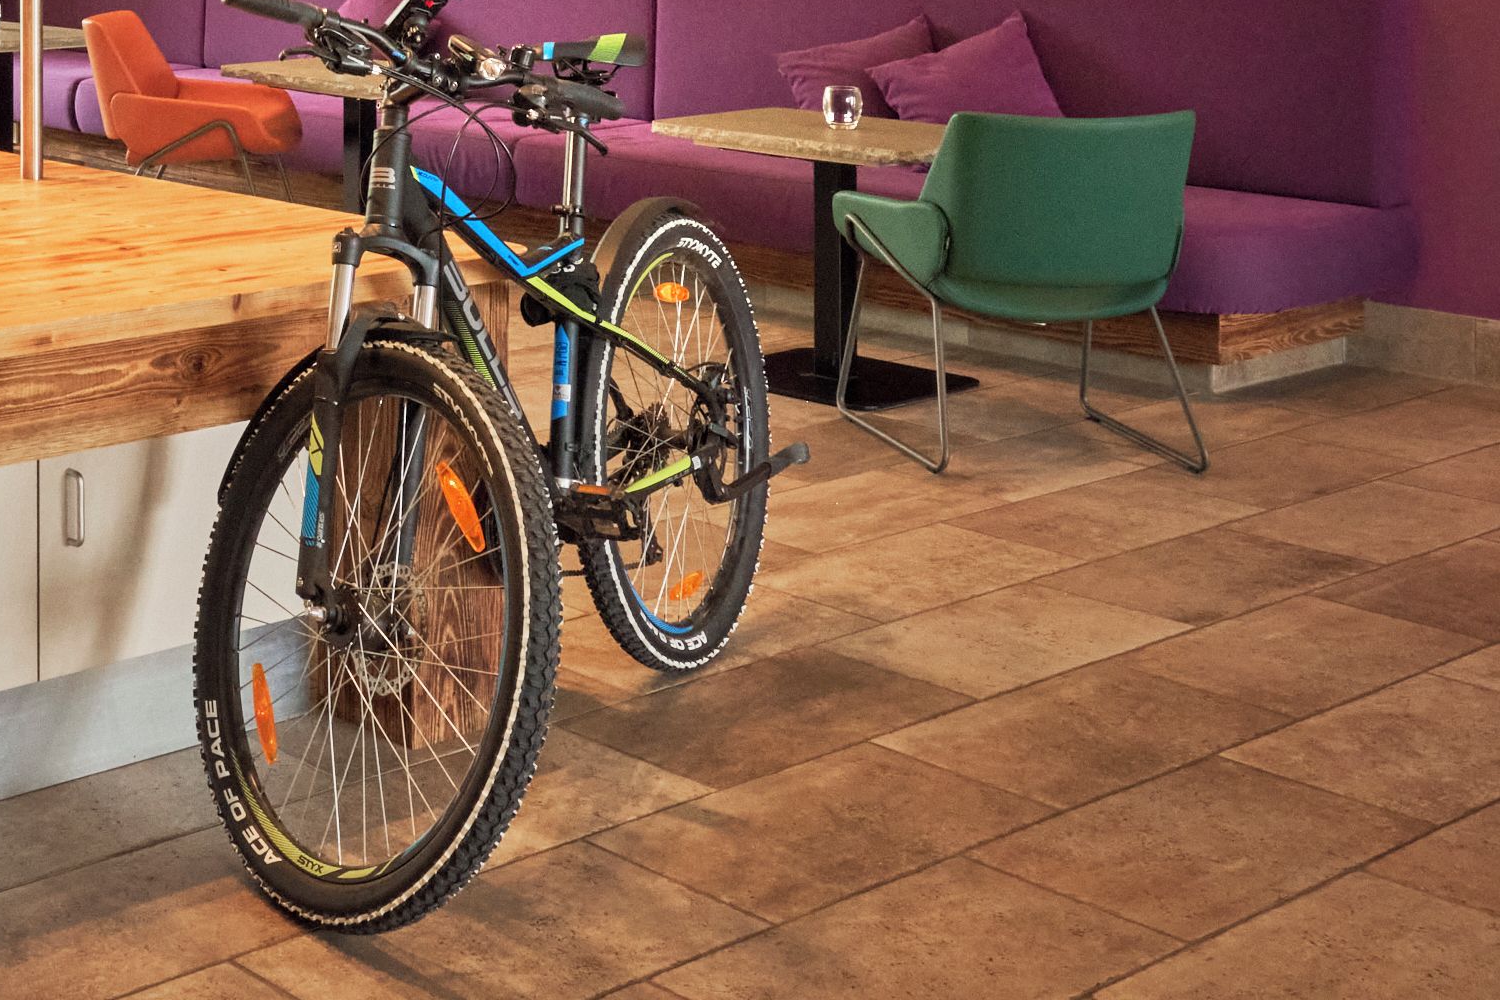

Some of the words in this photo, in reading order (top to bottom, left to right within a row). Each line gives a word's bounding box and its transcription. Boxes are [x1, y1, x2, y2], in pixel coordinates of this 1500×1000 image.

[204, 698, 231, 780] PACE
[223, 787, 247, 822] OF
[242, 824, 283, 866] ACE
[296, 854, 324, 875] STYX
